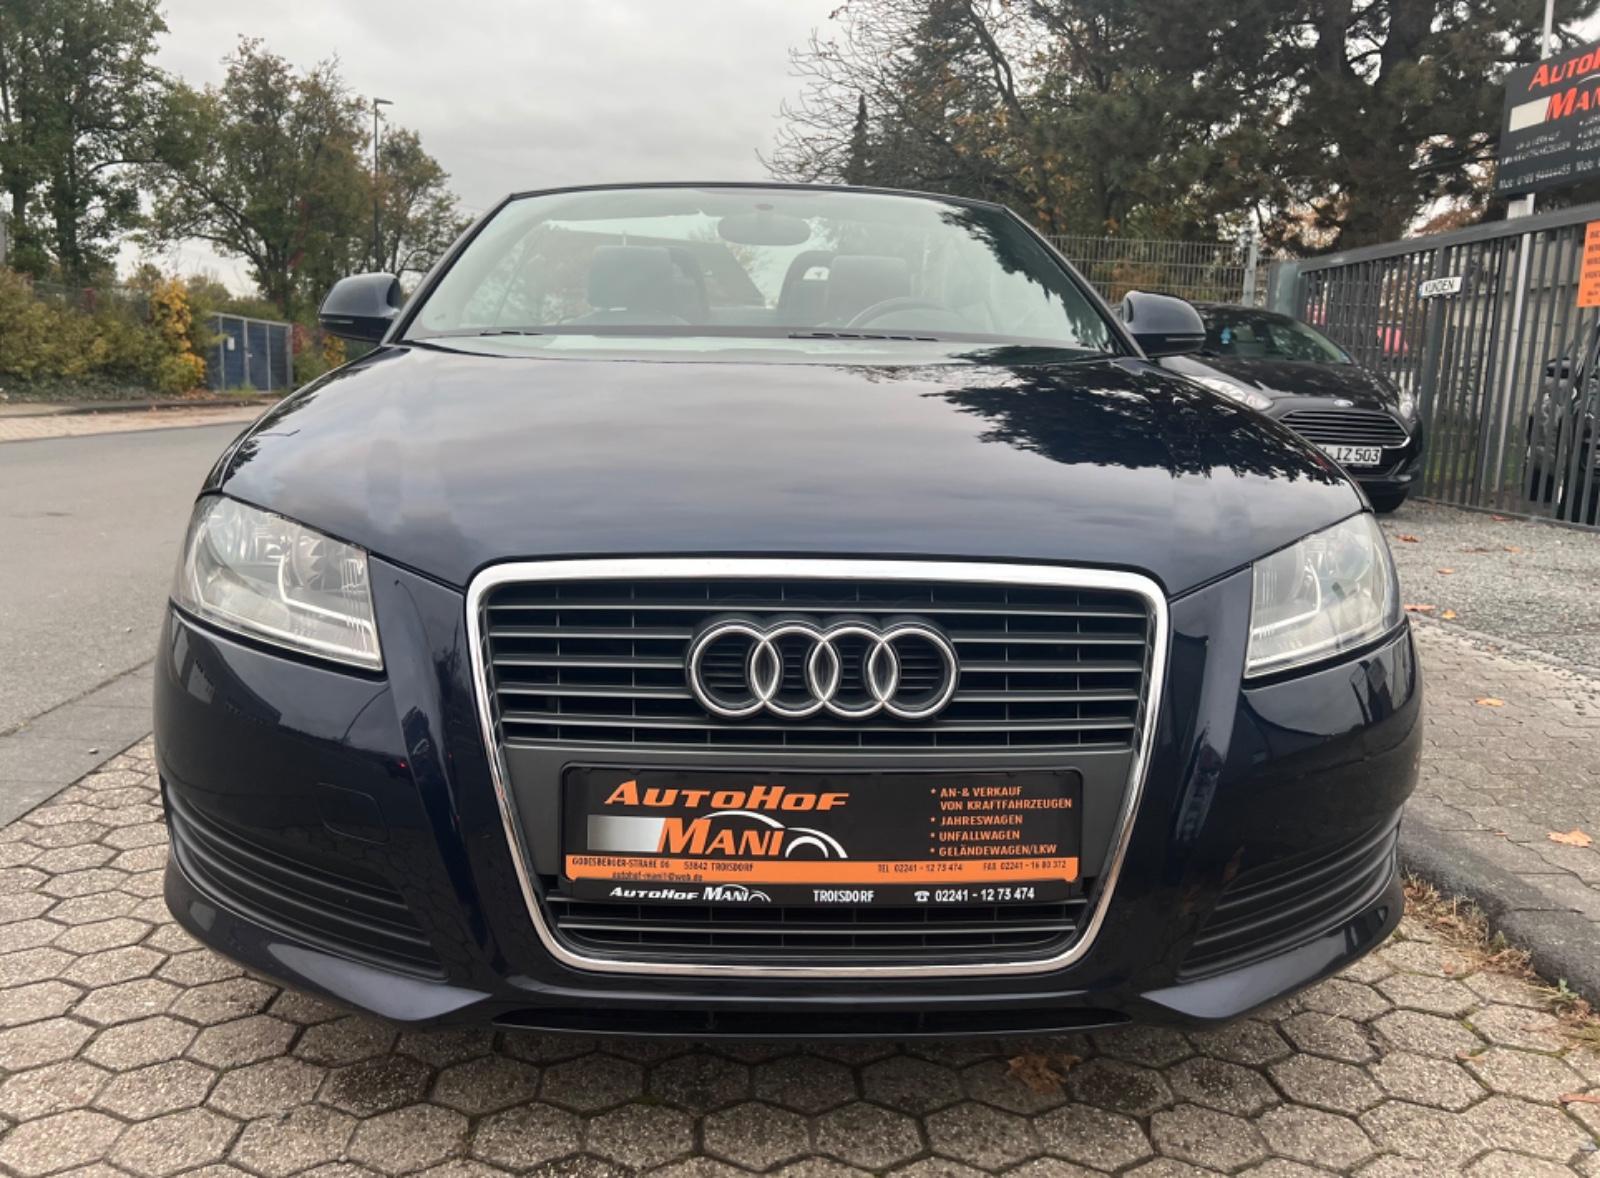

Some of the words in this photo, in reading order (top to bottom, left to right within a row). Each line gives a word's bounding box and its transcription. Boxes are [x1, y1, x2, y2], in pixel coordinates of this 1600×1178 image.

[1354, 448, 1380, 462] 503
[973, 786, 1023, 797] VERKAUF
[940, 800, 963, 811] VON
[967, 798, 1073, 810] KRAFTFAHRZEUGEN
[939, 814, 1023, 826] JAHRESWAGEN
[939, 830, 1020, 842] UNFALLWAGEN
[939, 844, 1058, 857] GELÄNDEWAGEN/LKW
[711, 862, 753, 872] TROISDORF
[894, 864, 917, 872] 02241
[1000, 862, 1023, 870] 02241
[813, 889, 874, 902] TROISDORF
[935, 889, 968, 902] 02241
[980, 888, 994, 901] 12
[1013, 887, 1035, 900] 474
